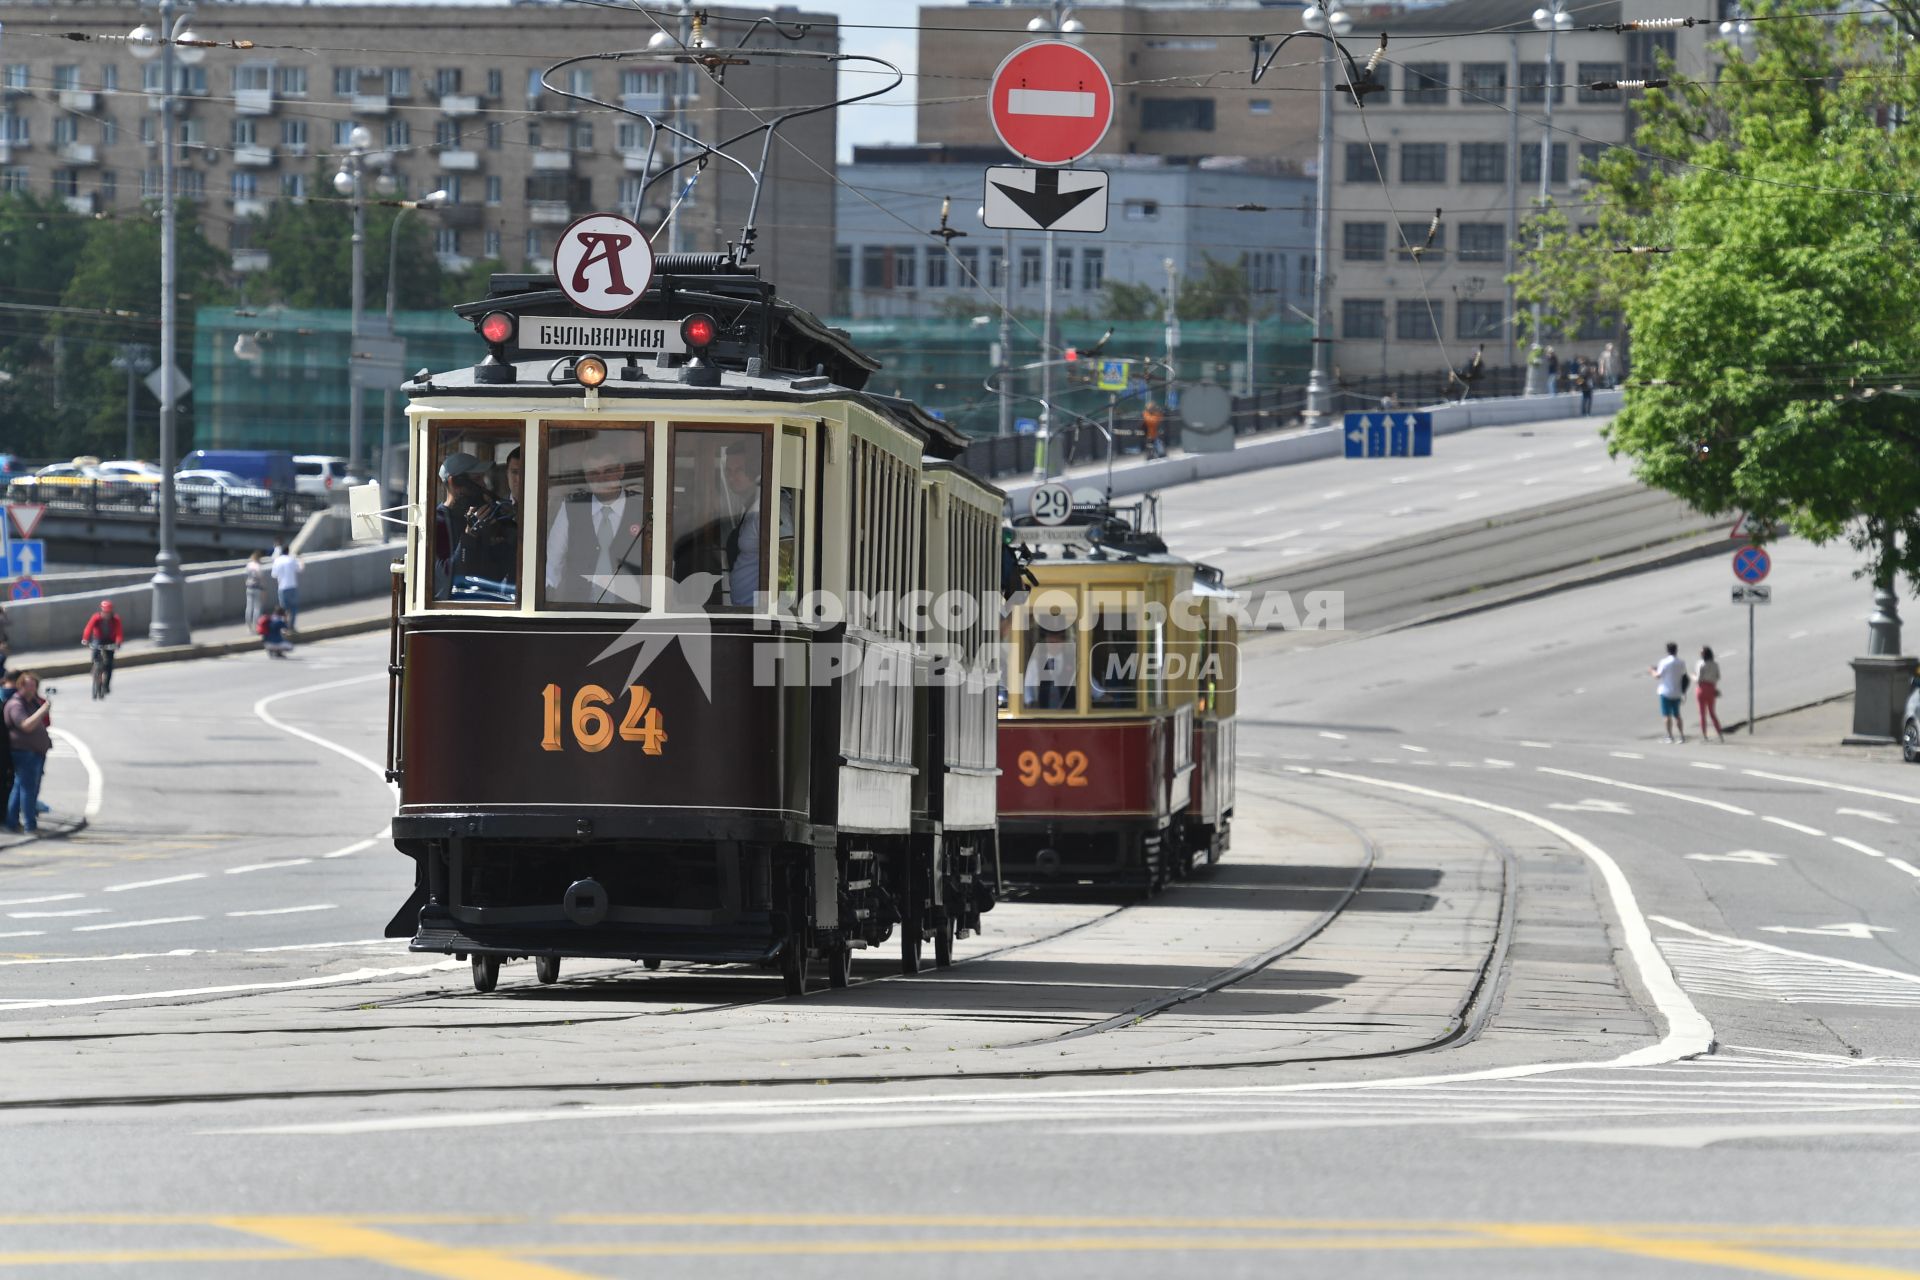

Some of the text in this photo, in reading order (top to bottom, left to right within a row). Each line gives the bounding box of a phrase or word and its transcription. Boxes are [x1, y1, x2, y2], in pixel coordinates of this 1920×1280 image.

[540, 325, 665, 348] БУЛЬВАРНАЯ
[1036, 490, 1068, 518] 29
[540, 683, 668, 755] 164
[1018, 750, 1089, 787] 932
